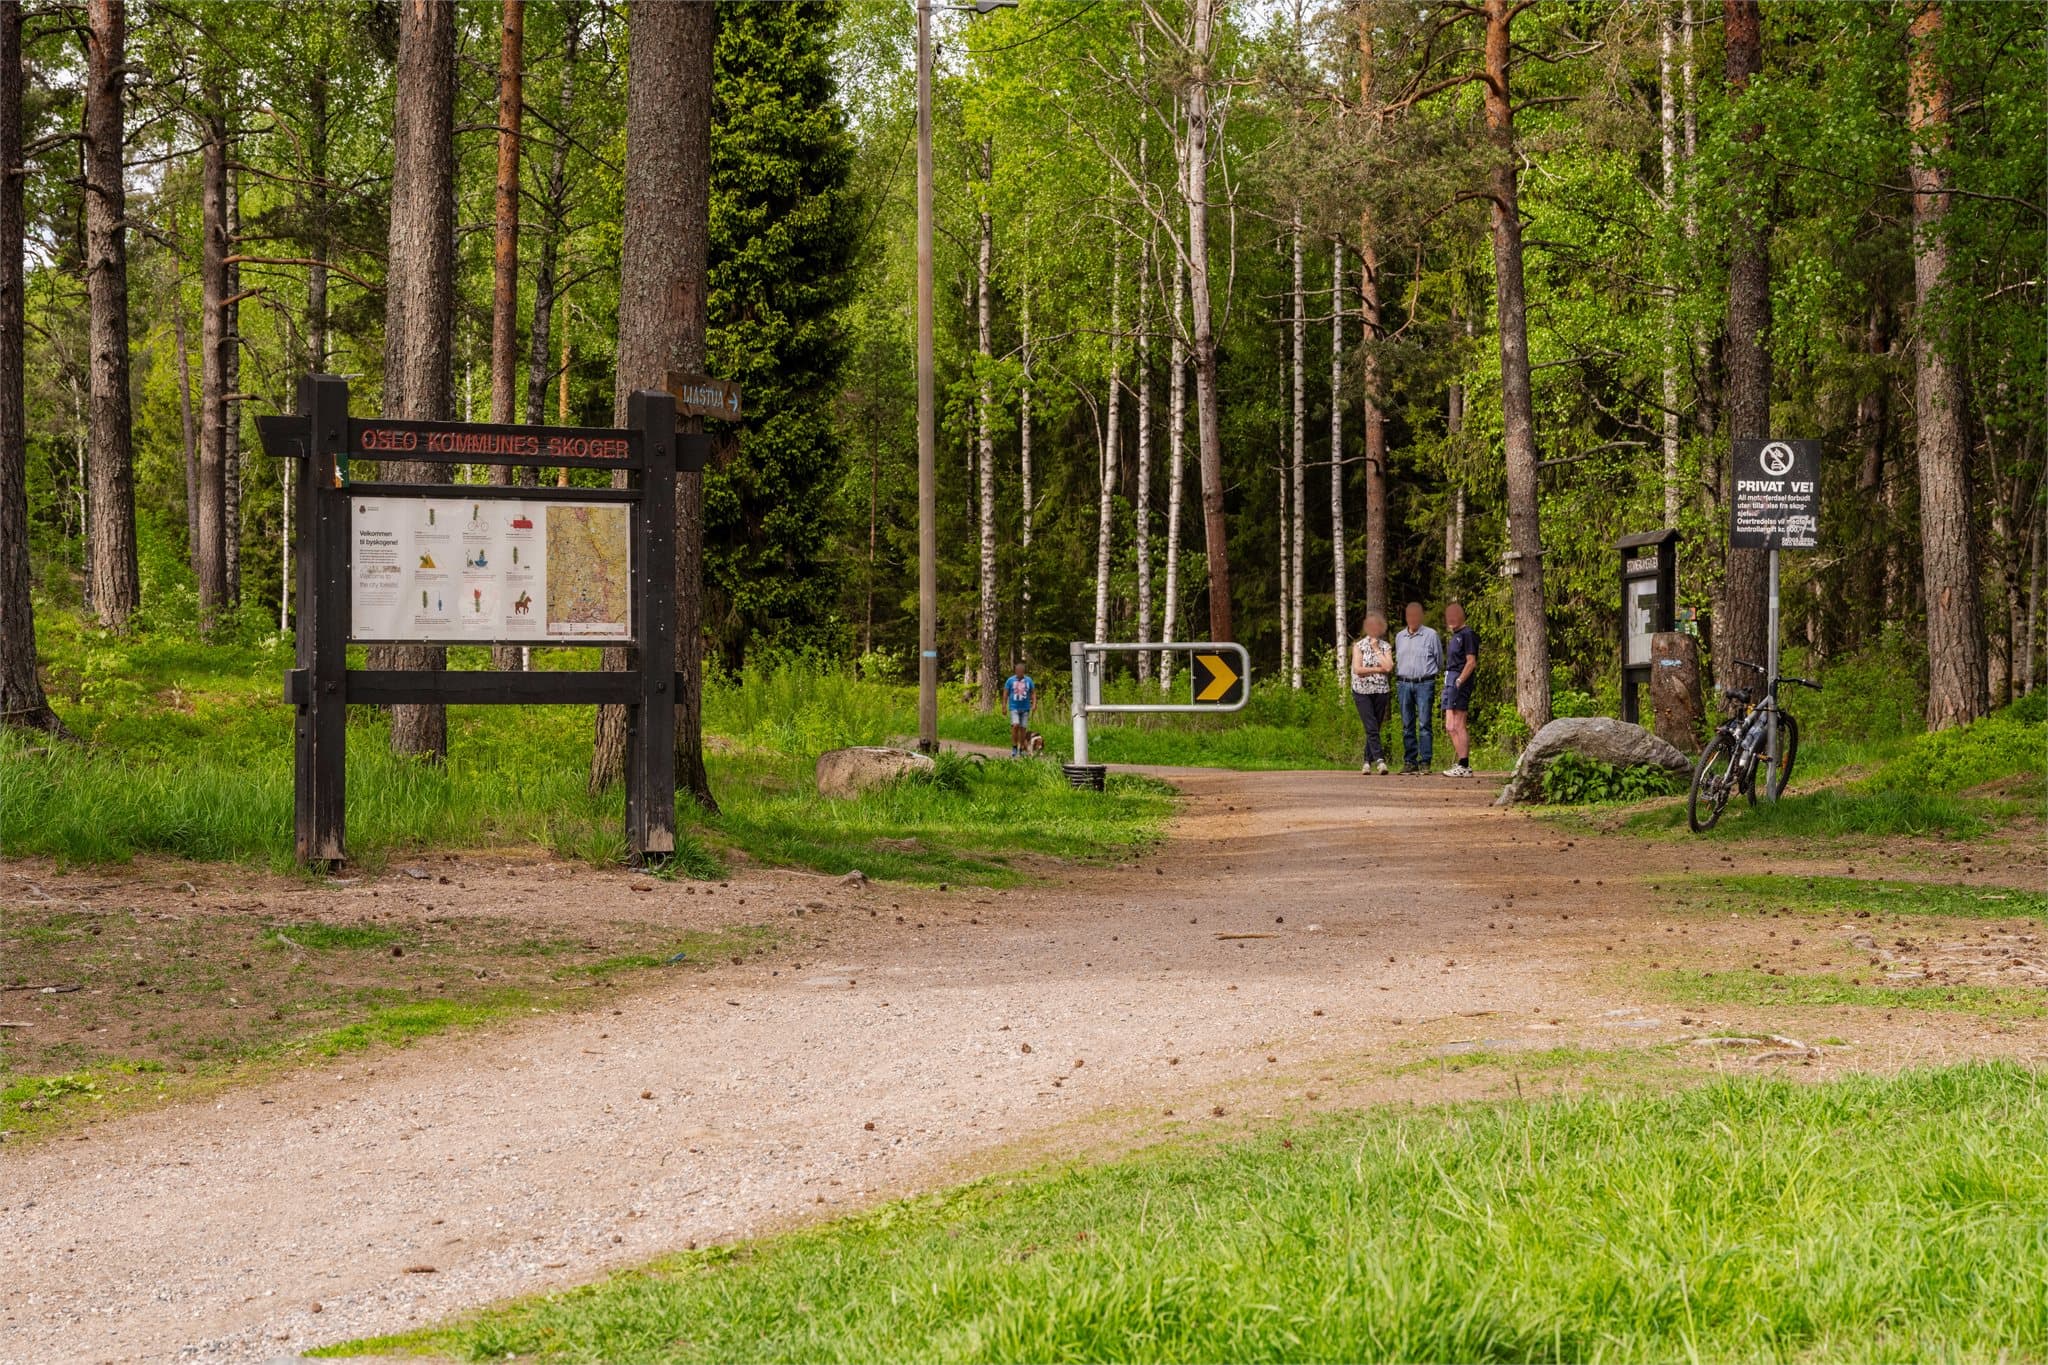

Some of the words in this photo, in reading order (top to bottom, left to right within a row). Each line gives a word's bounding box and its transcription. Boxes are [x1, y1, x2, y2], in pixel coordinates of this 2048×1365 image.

[683, 384, 724, 408] LIASTUA
[361, 429, 418, 451] OSLO
[428, 432, 540, 457] KOMMUNES
[547, 437, 630, 459] SKOGER
[1737, 480, 1785, 493] PRIVAT
[1791, 481, 1814, 493] VEI
[1788, 494, 1811, 502] forbudt
